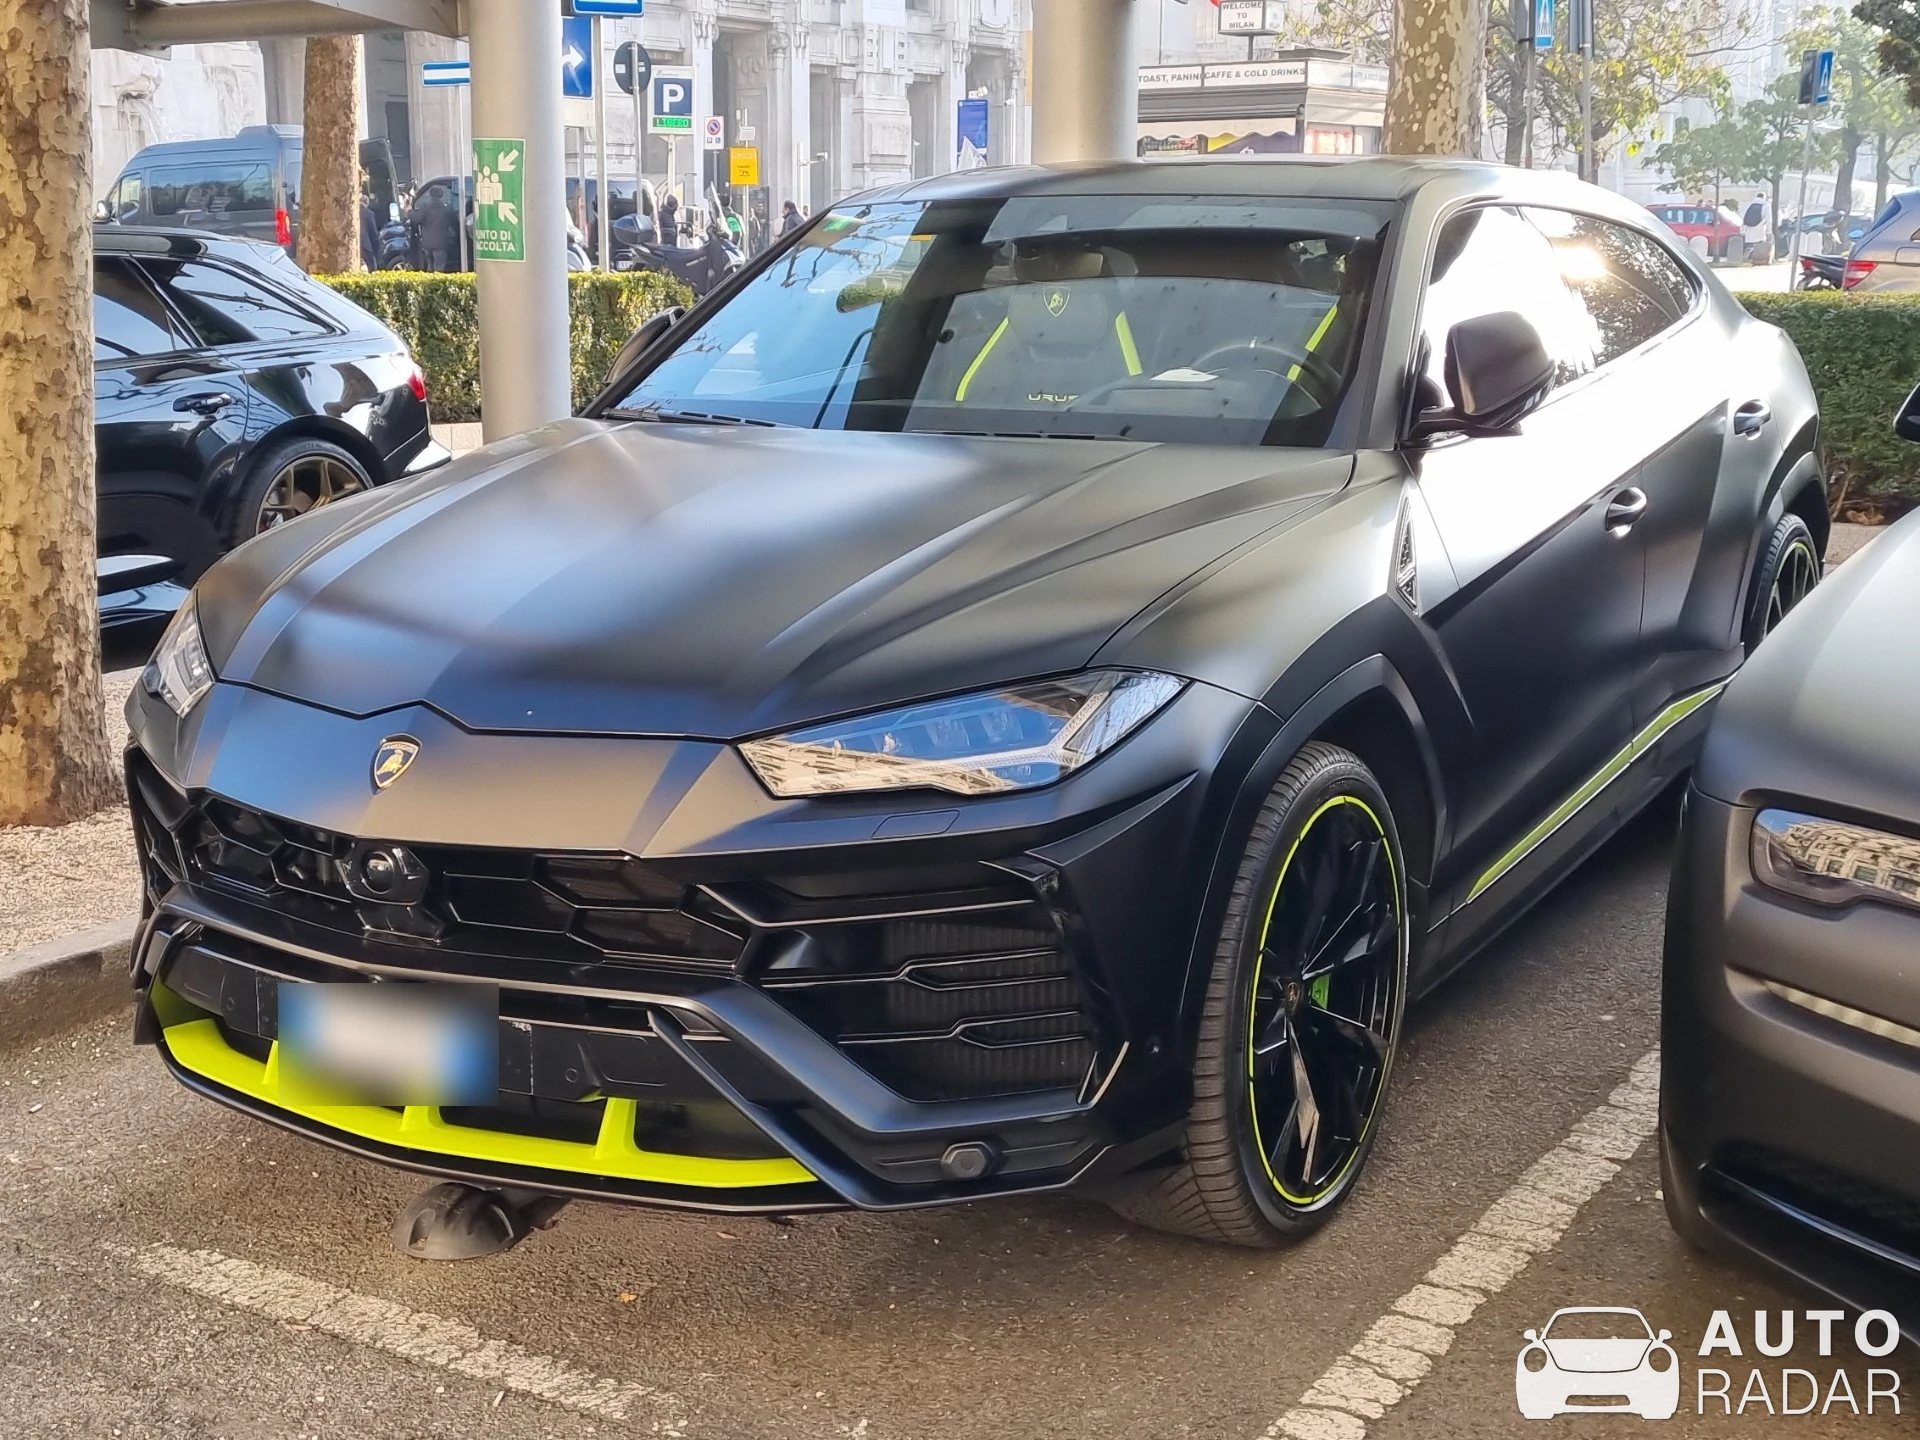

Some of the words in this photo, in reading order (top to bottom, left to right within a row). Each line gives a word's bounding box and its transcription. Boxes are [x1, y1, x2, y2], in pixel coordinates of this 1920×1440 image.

[1223, 2, 1262, 10] WELCOME
[1229, 21, 1255, 29] MILAN
[1138, 74, 1169, 83] TOAST,
[1204, 71, 1232, 79] CAFFE
[1235, 70, 1241, 78] &
[1244, 69, 1268, 77] COLD
[1271, 67, 1306, 76] DRINKS
[662, 83, 685, 113] P
[656, 117, 689, 128] LIBERO
[500, 230, 511, 241] DI
